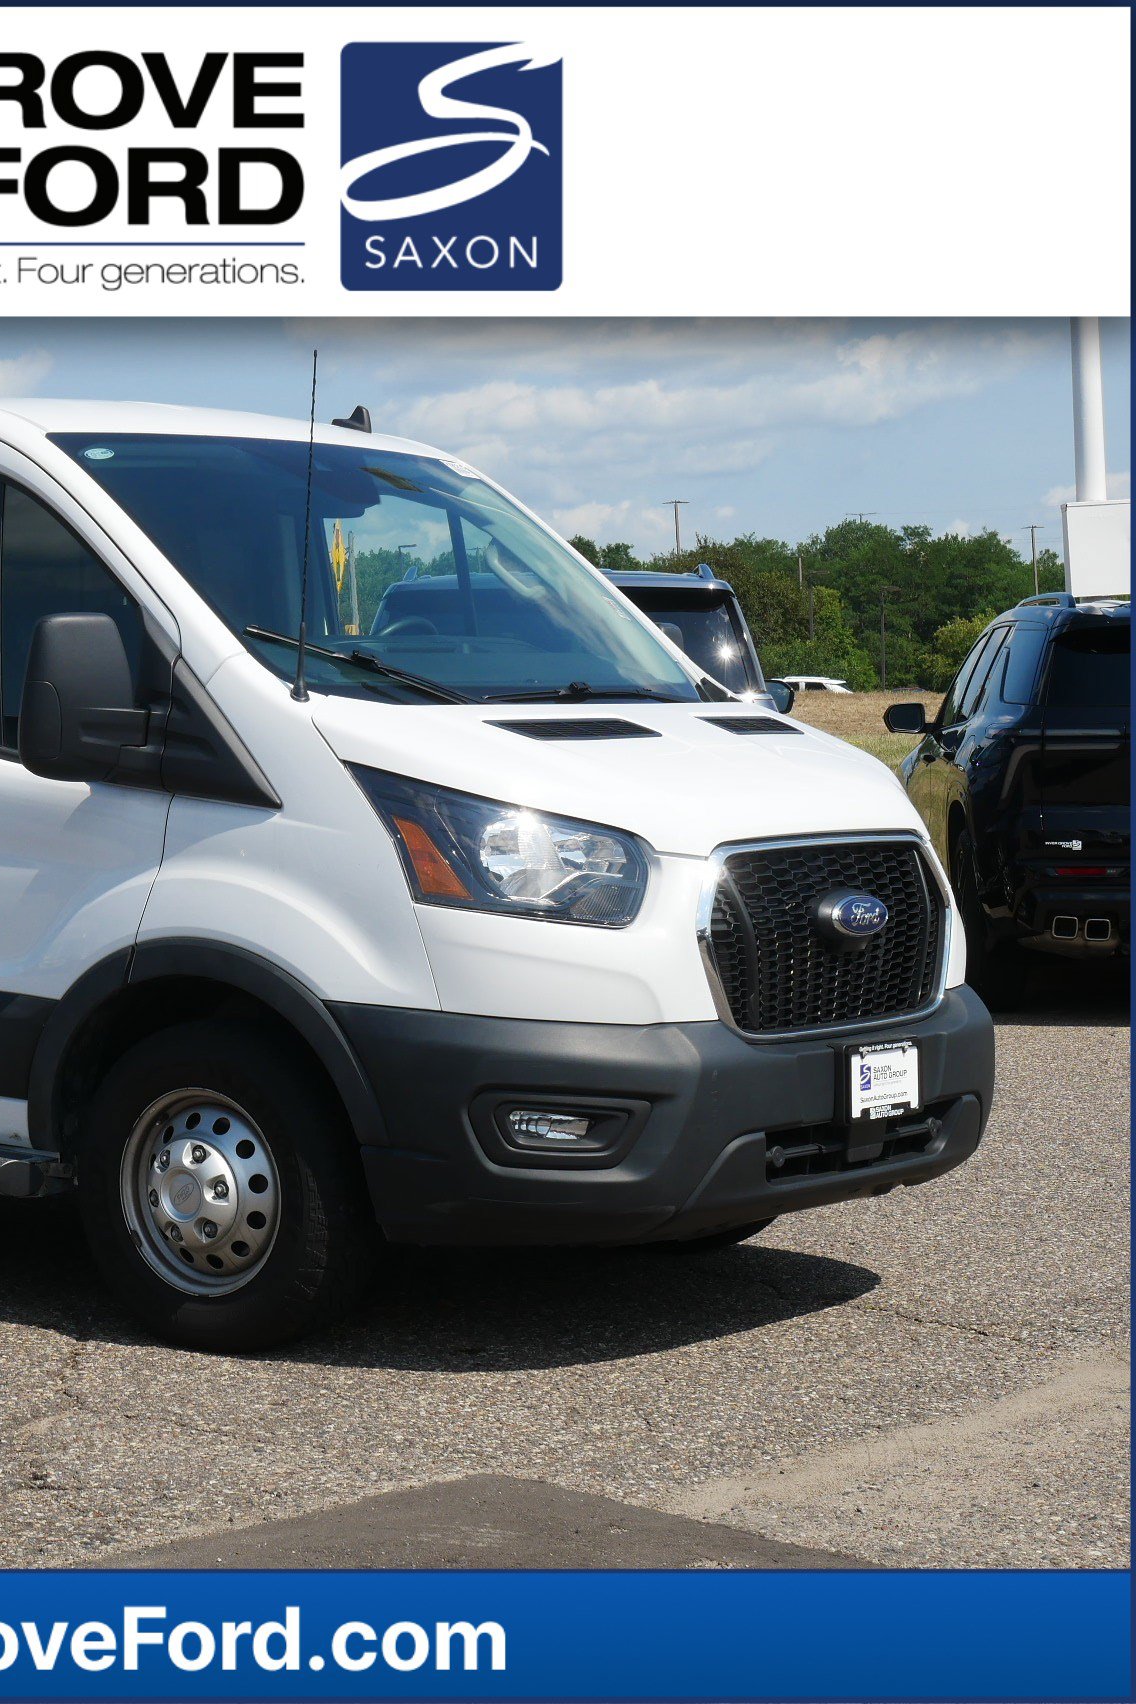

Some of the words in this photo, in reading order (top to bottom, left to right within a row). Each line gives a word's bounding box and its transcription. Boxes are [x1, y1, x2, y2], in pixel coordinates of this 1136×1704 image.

[873, 1065, 892, 1073] SAXON
[873, 1072, 888, 1080] AUTO
[888, 1069, 908, 1079] GROUP
